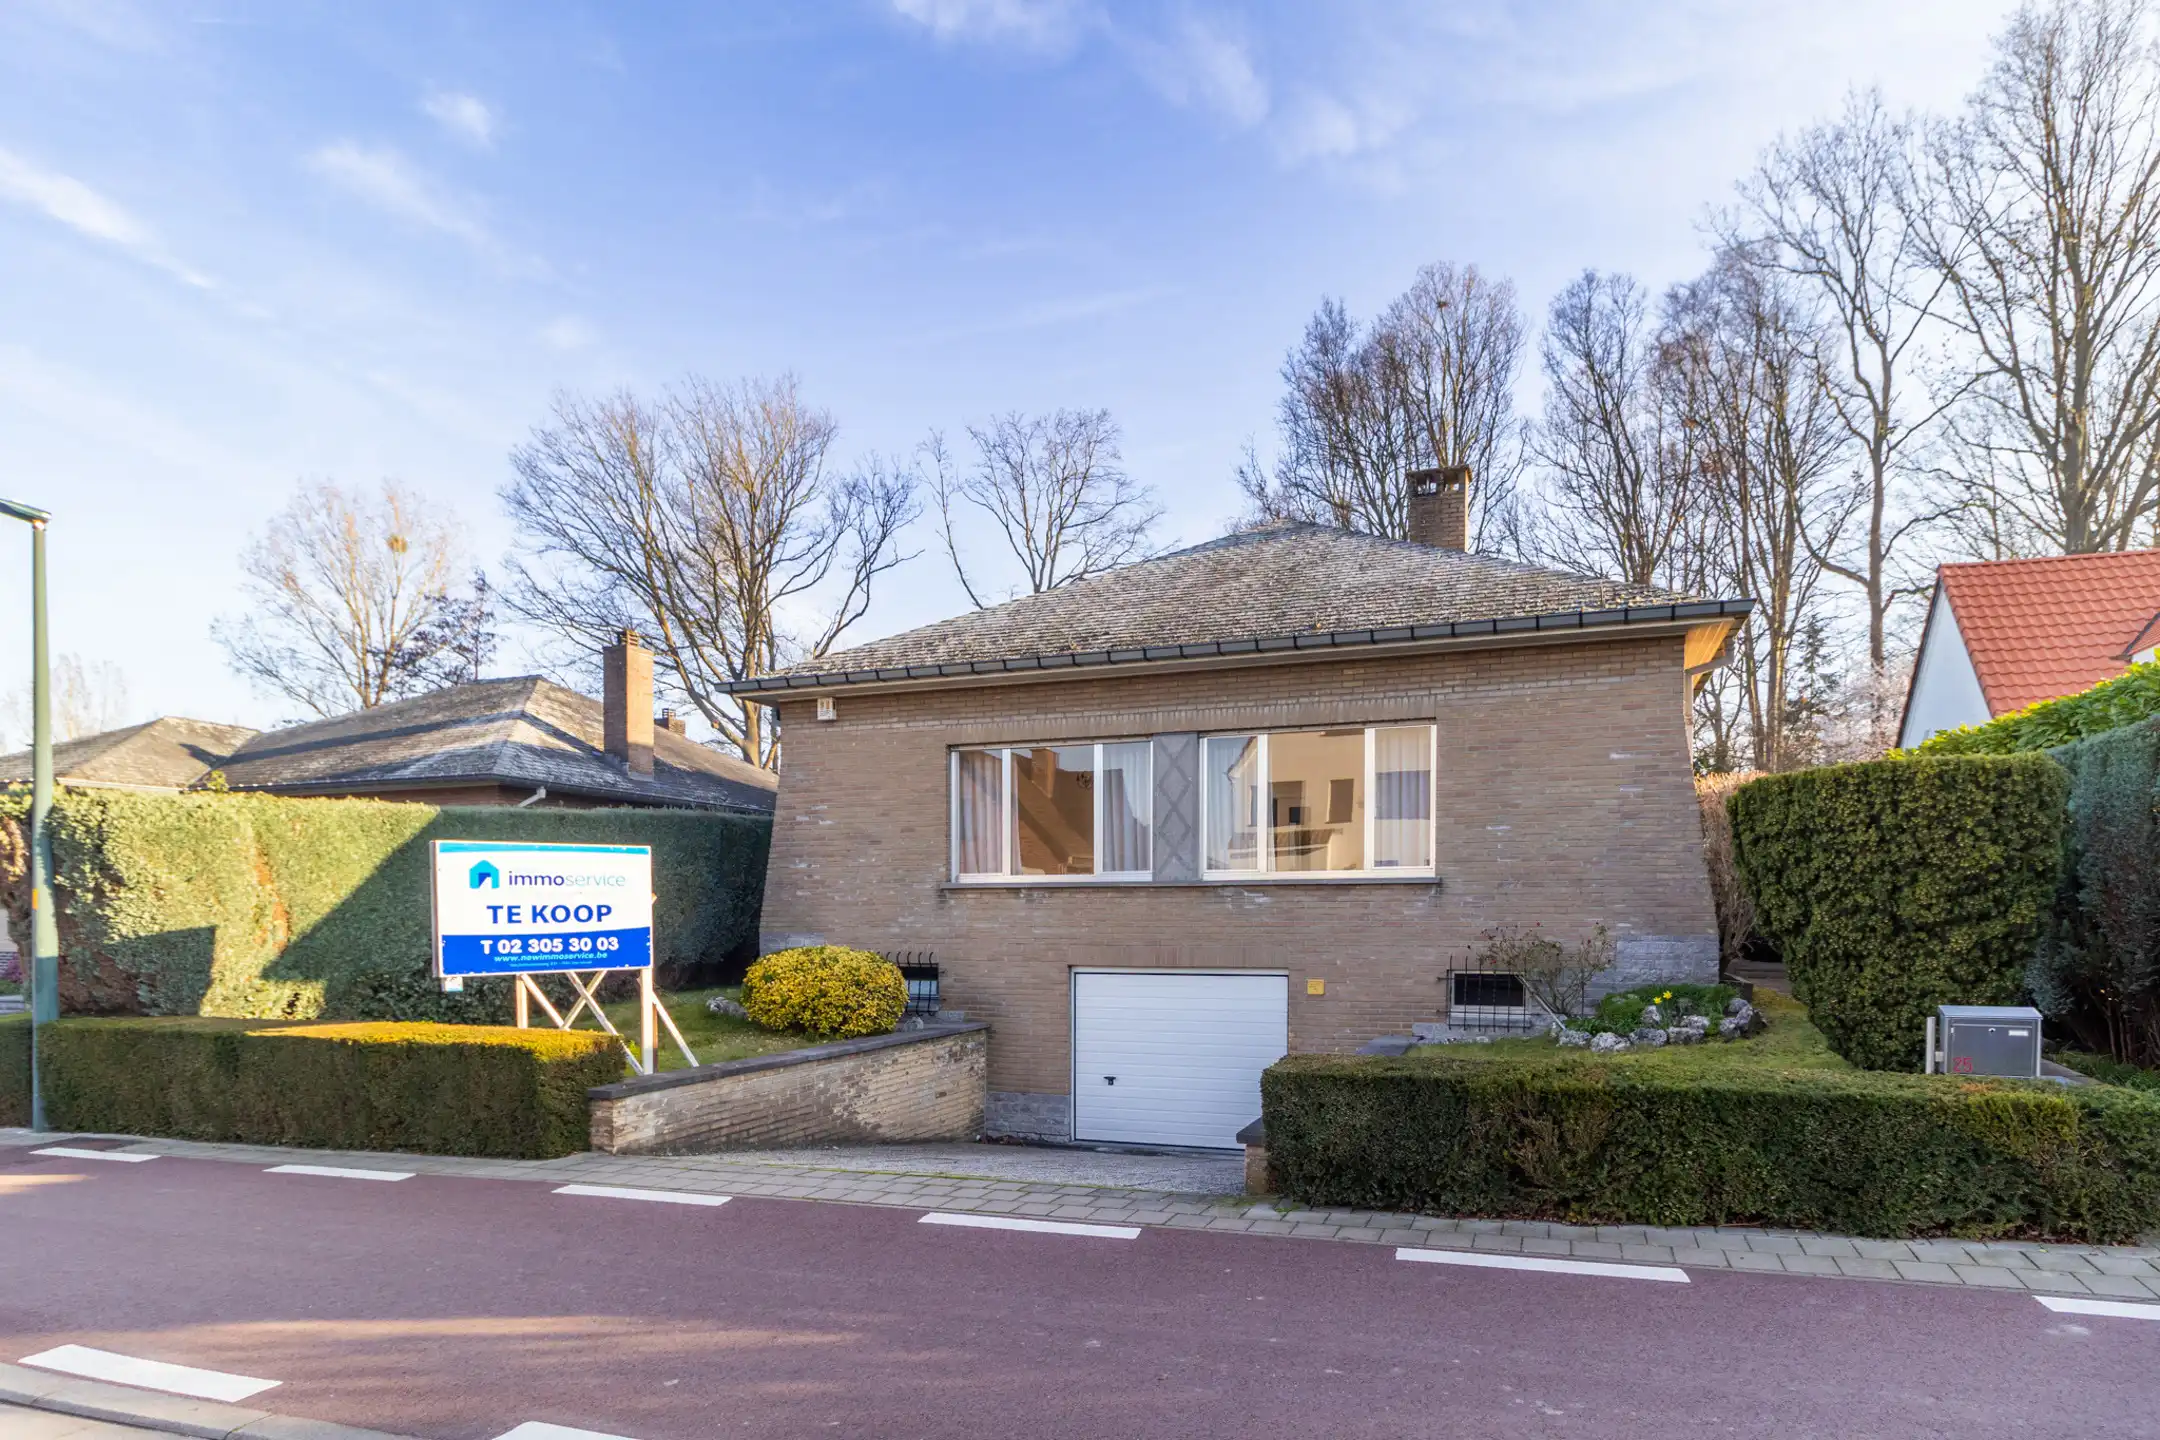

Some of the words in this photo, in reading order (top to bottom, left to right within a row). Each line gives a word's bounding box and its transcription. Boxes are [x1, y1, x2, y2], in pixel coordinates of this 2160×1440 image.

[508, 870, 626, 887] immoservice
[486, 904, 523, 925] TE
[531, 904, 613, 924] KOOP
[480, 940, 494, 955] T
[497, 939, 523, 954] 02
[528, 938, 564, 953] 305
[568, 937, 593, 952] 30
[596, 936, 620, 951] 03
[494, 951, 608, 963] www.newimmoservice.be
[1952, 1056, 1973, 1073] 25
